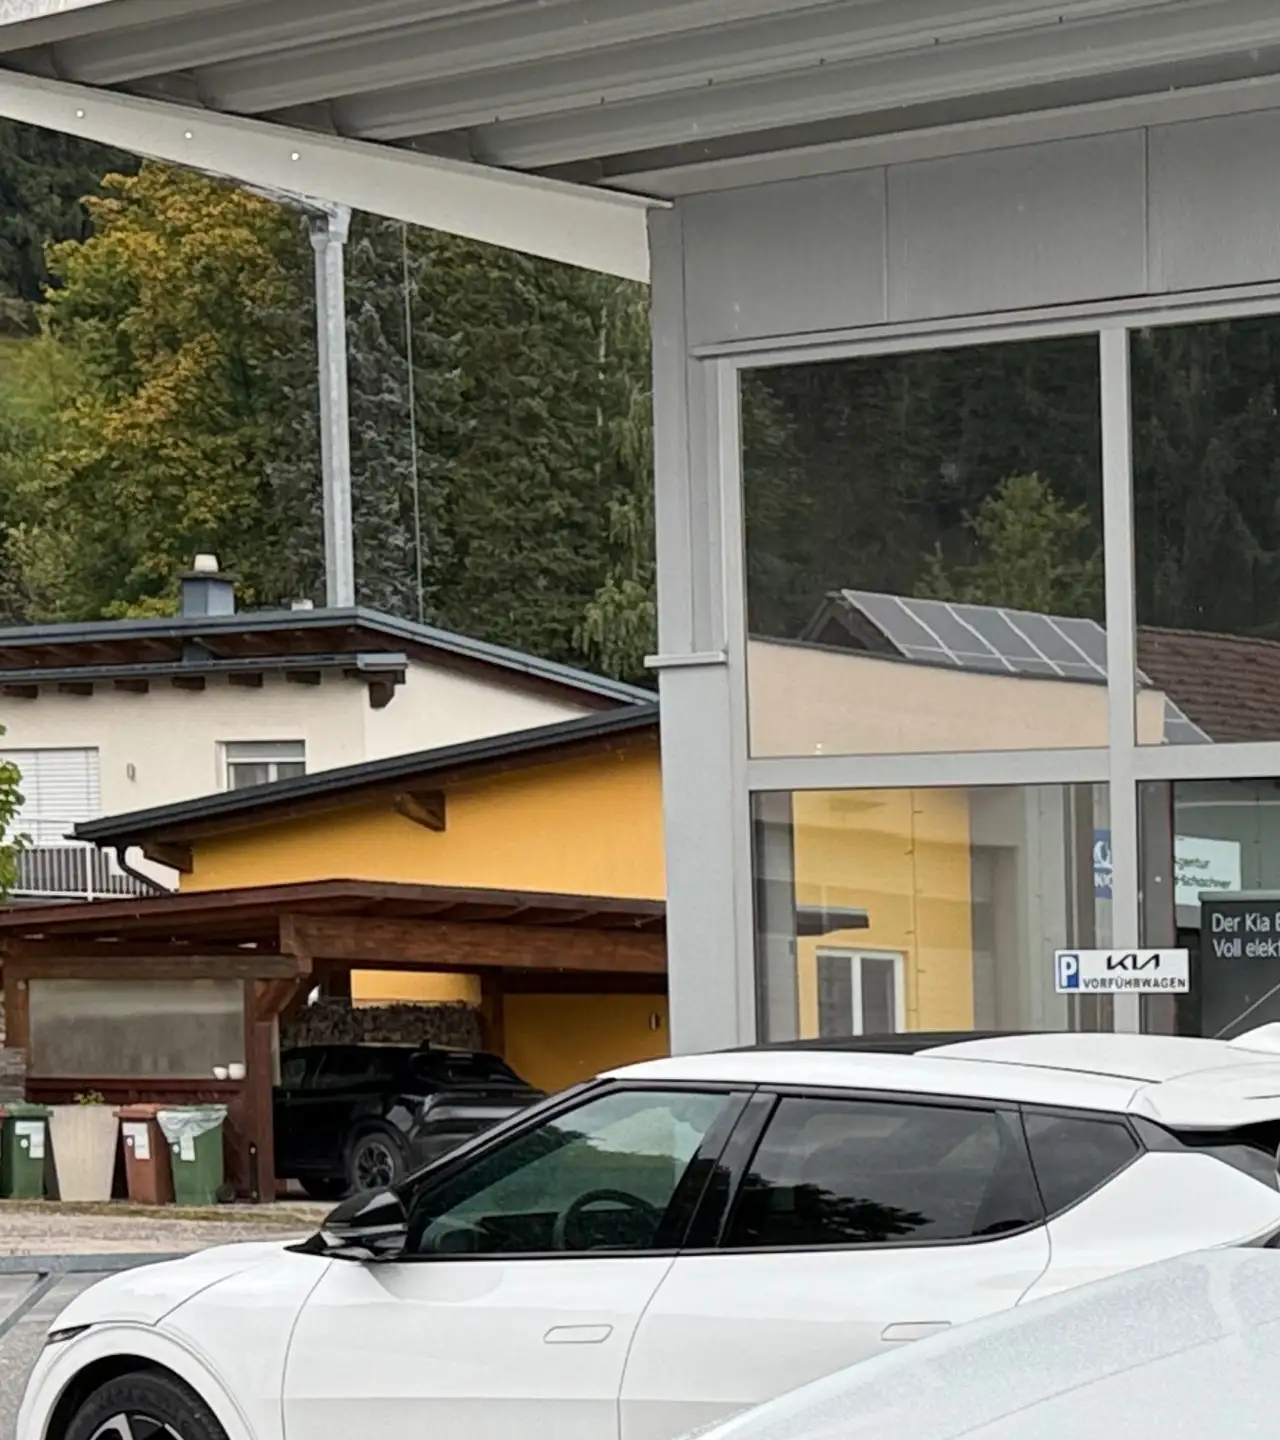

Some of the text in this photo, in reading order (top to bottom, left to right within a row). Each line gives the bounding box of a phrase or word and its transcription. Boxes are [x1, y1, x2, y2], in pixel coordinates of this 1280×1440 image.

[1211, 912, 1241, 933] Der
[1244, 911, 1271, 933] Kia
[1211, 937, 1242, 959] Voll
[1106, 953, 1161, 971] KIA
[1082, 975, 1187, 990] VORFÜHRWAGEN
